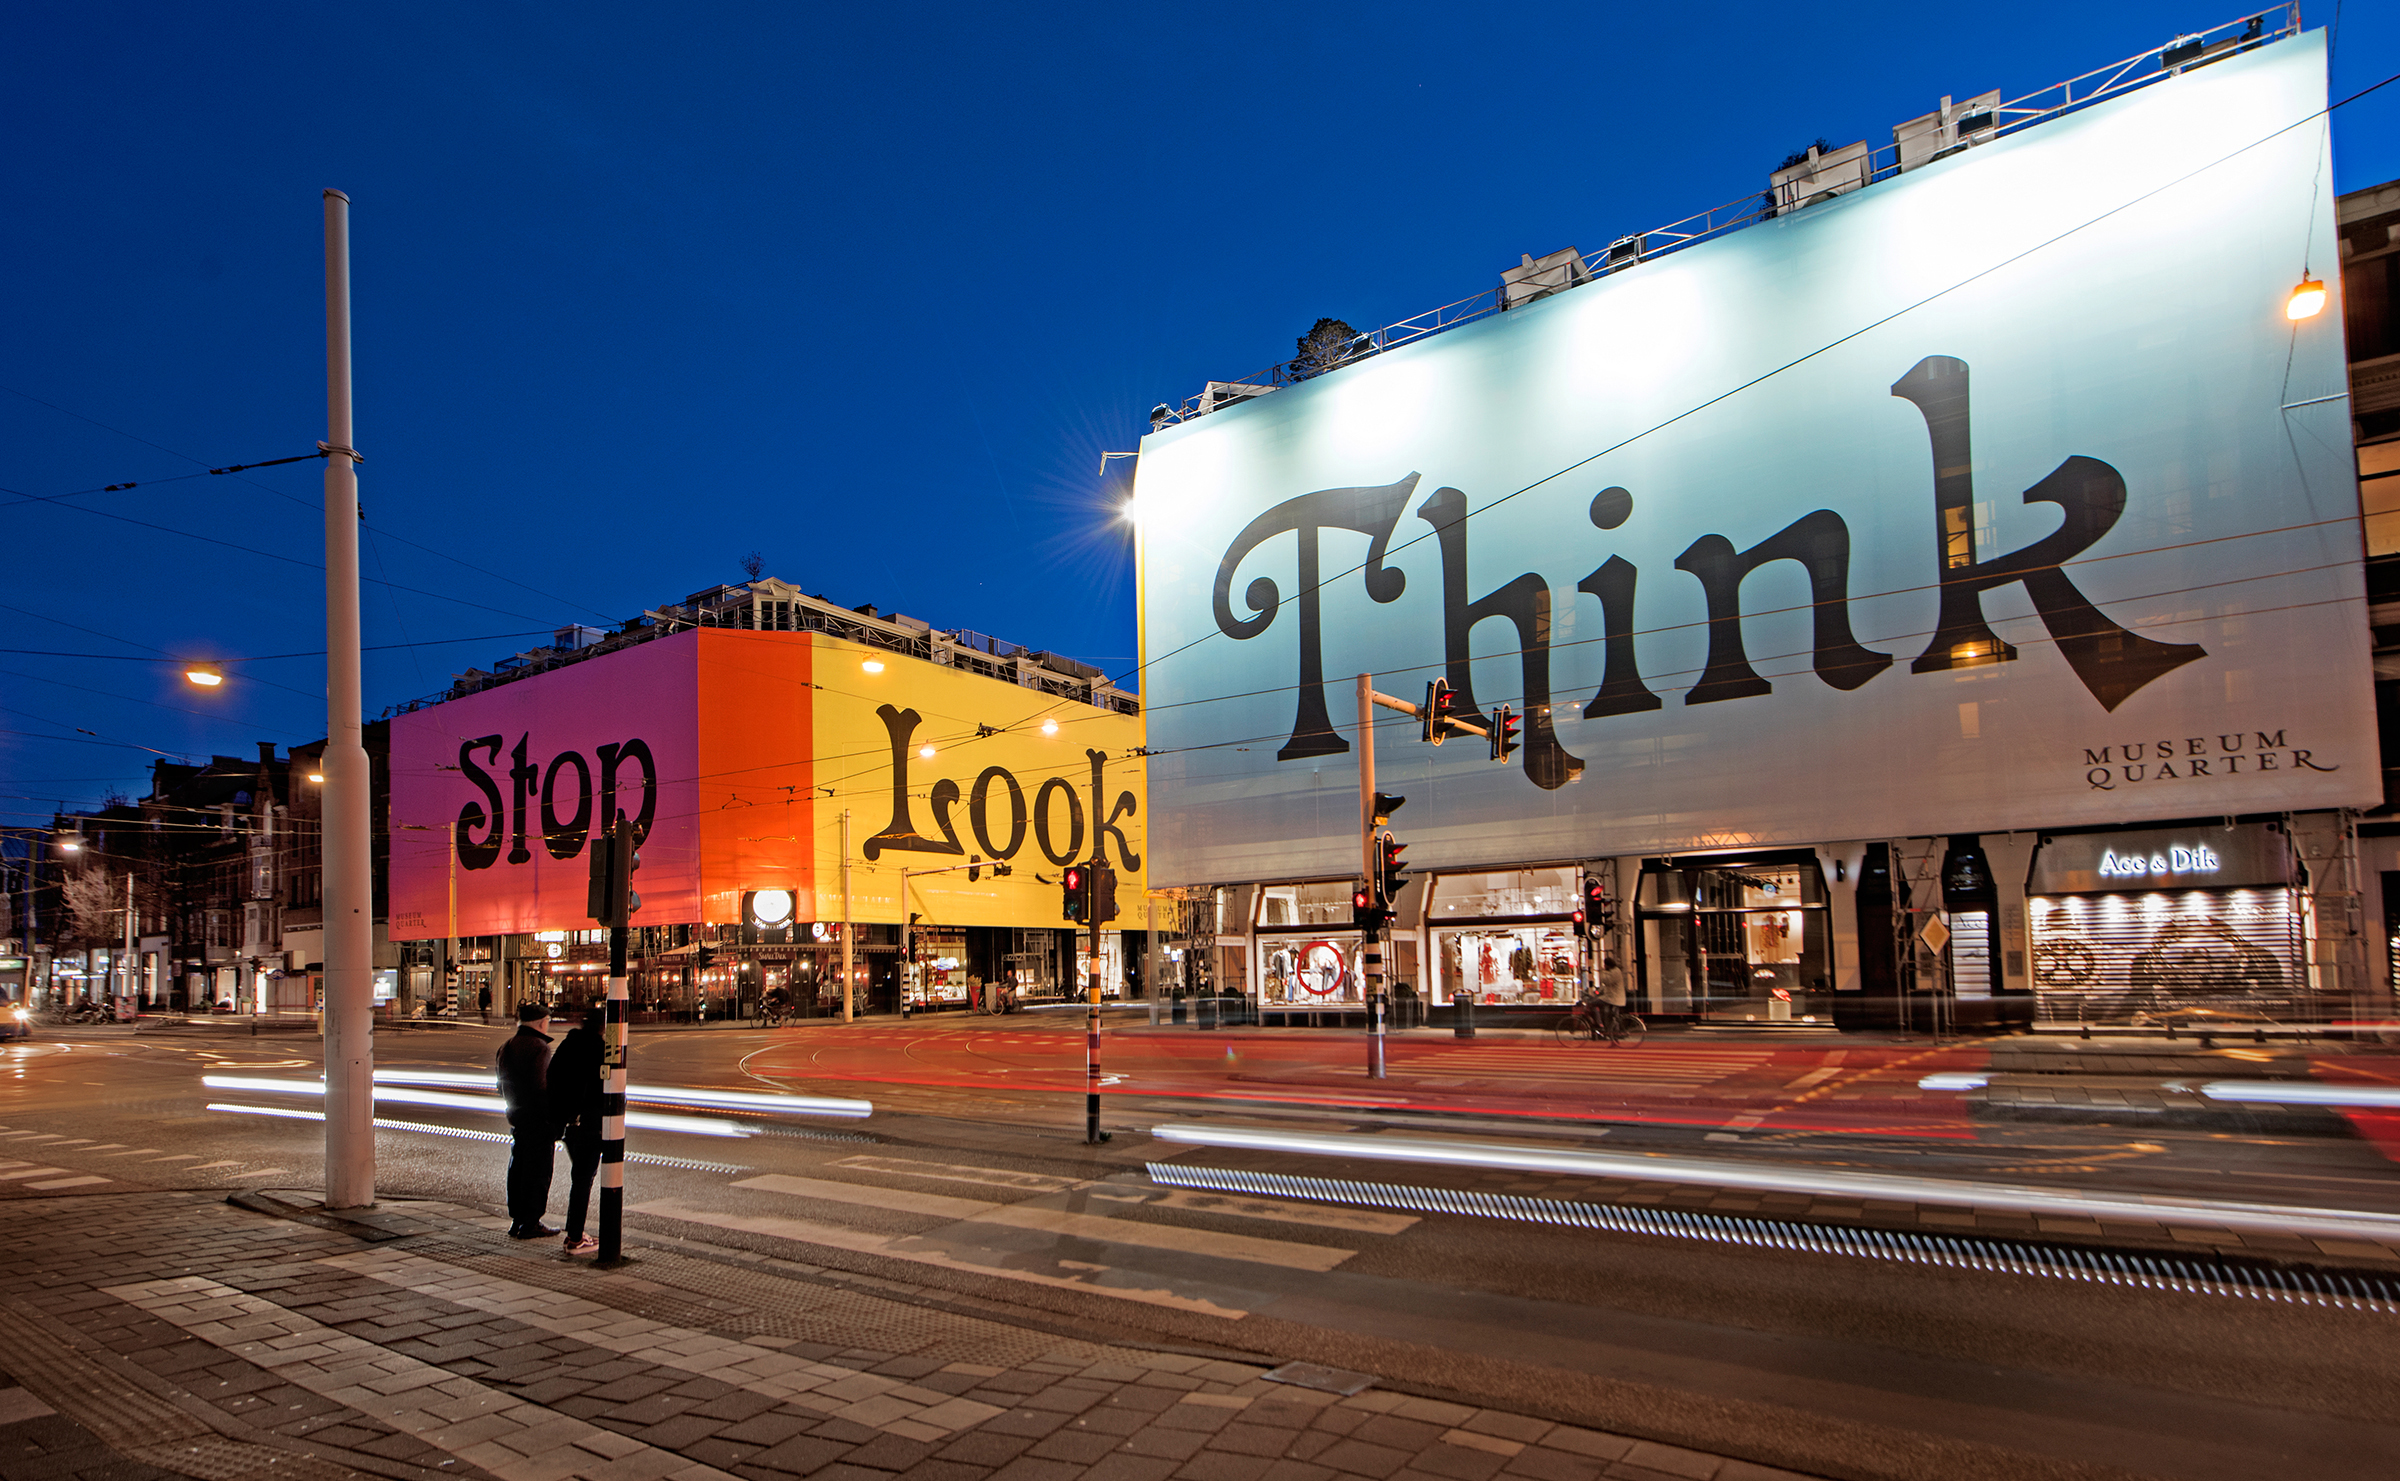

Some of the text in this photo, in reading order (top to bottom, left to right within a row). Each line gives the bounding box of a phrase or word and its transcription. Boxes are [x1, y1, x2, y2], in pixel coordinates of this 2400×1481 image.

[1212, 354, 2208, 790] Think
[2083, 729, 2289, 766] MUSEUM
[862, 703, 1141, 873] Look
[2086, 750, 2340, 791] QUARTER
[456, 731, 657, 871] Stop
[2150, 853, 2169, 876] &
[2170, 844, 2220, 875] Dik
[396, 912, 422, 920] MUSEUM
[396, 919, 428, 930] QUARTER
[1137, 904, 1168, 912] MUUM
